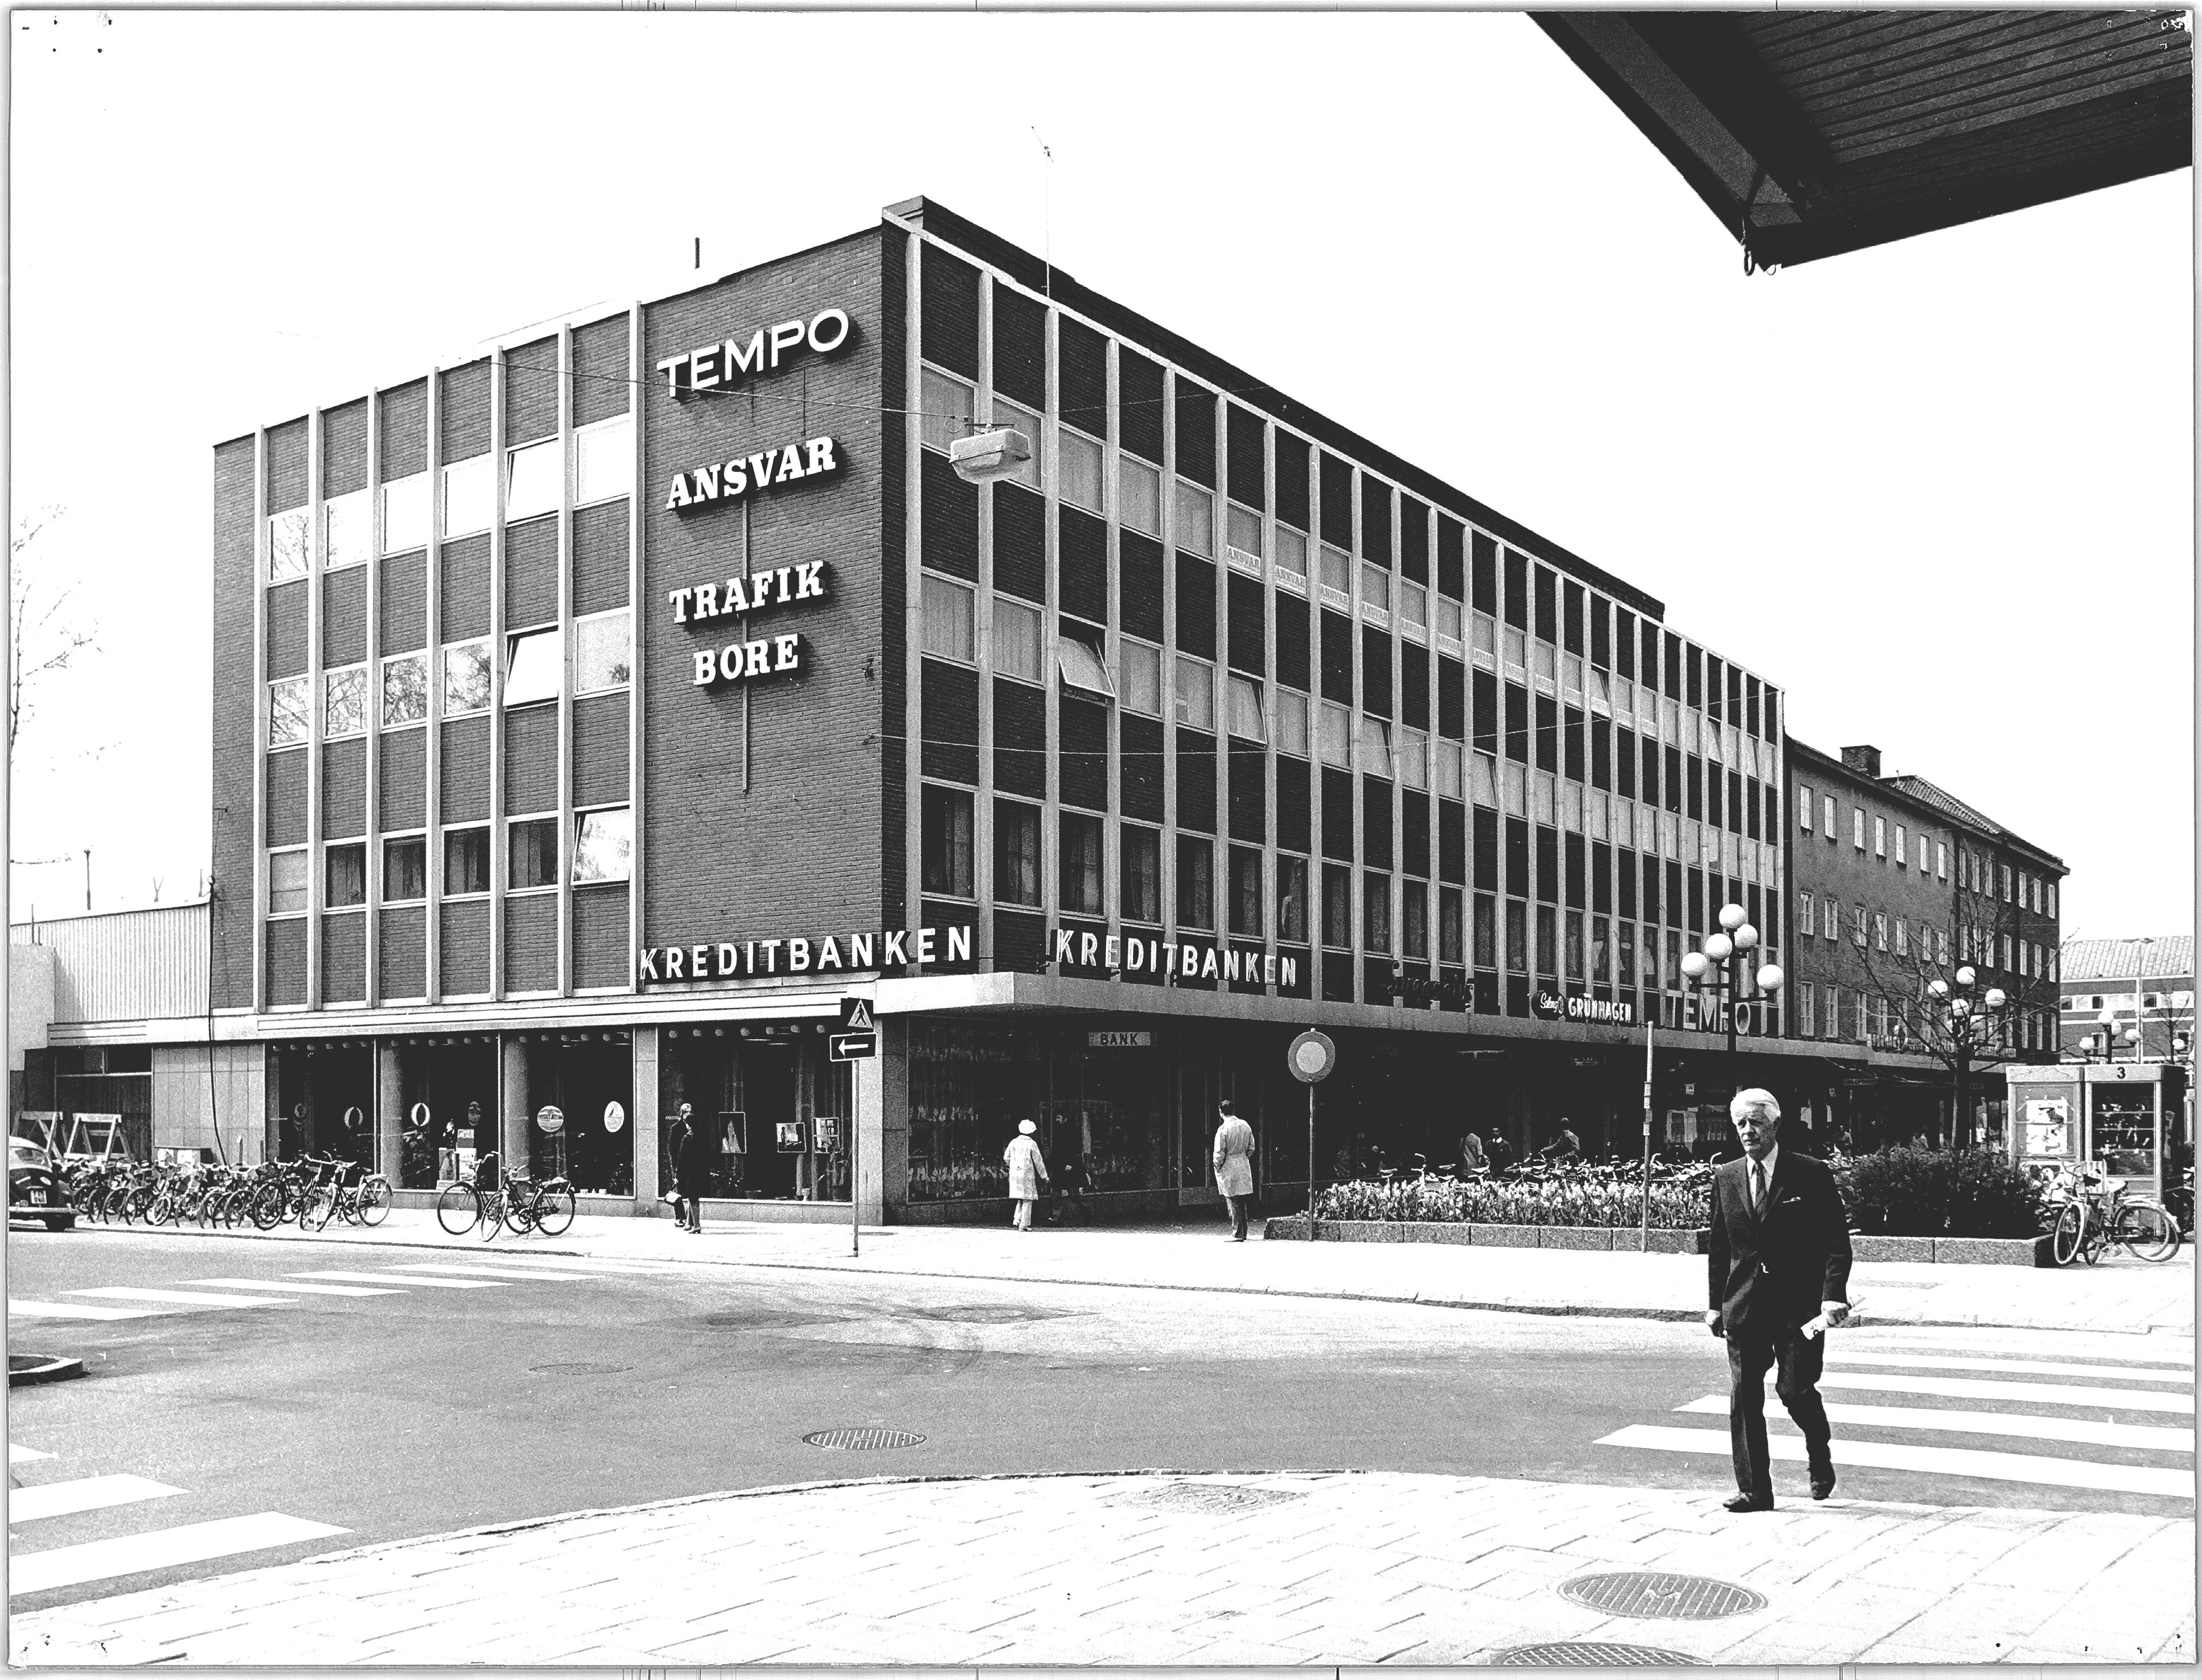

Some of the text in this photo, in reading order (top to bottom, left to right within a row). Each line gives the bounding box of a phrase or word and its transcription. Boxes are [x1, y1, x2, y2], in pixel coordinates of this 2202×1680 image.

[657, 308, 849, 397] TEMPO
[666, 436, 836, 510] ANSVAR
[1227, 547, 1259, 570] ANSVAR
[669, 560, 824, 624] TRAFIK
[693, 633, 799, 686] BORE
[640, 926, 971, 979] KREDITBANKEN
[1056, 929, 1296, 986] KREDITBANKEN
[1568, 993, 1631, 1023] GRÜNHAGEN
[1100, 1033, 1139, 1046] BANK
[2117, 1067, 2126, 1079] 3
